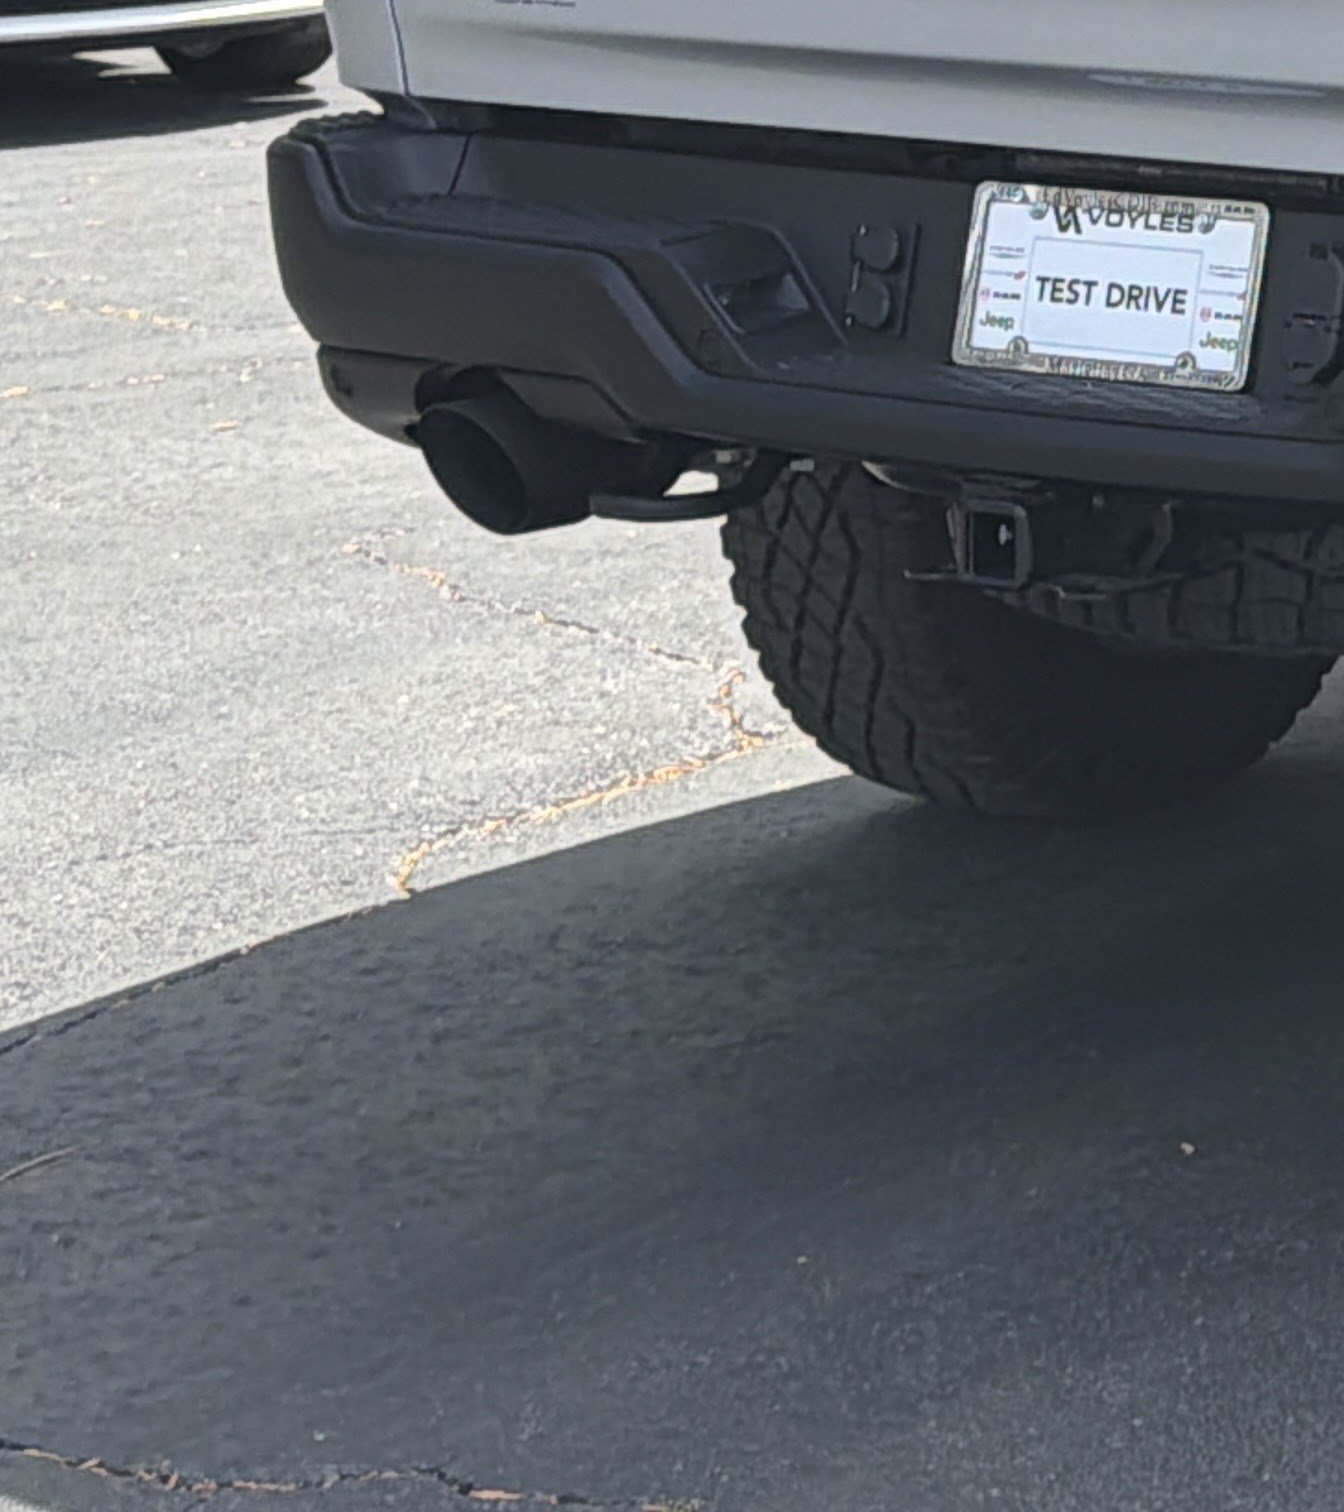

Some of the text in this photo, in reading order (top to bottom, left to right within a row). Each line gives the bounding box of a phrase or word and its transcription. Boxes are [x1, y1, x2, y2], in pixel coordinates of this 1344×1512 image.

[1086, 205, 1195, 233] VOYLES
[1035, 276, 1188, 315] TEST DRIVE
[979, 310, 1014, 332] Jeep
[1199, 331, 1239, 354] Jeep
